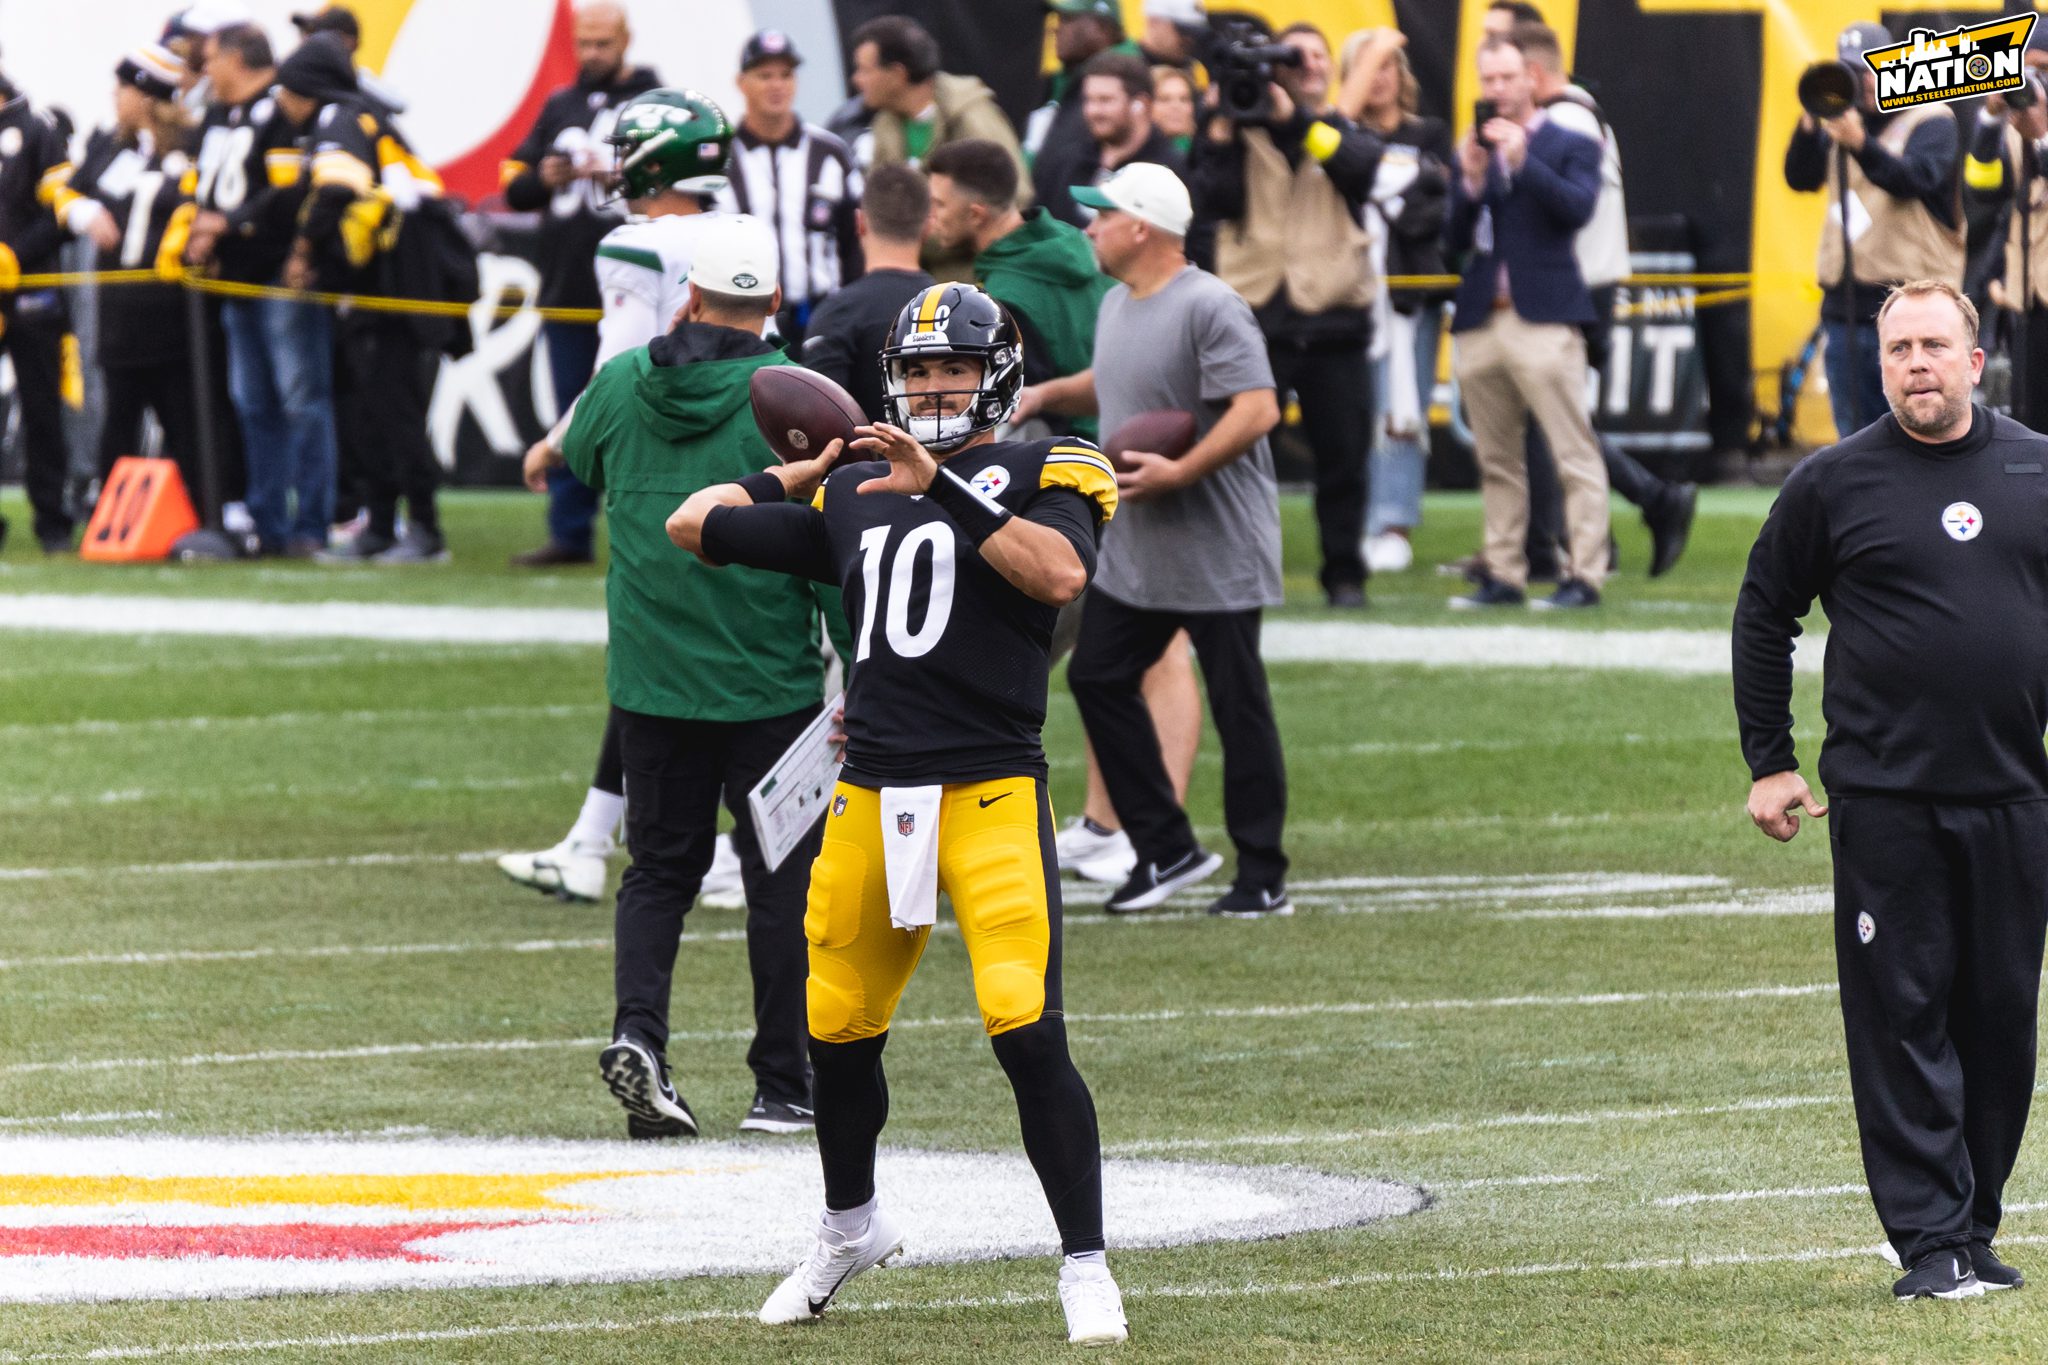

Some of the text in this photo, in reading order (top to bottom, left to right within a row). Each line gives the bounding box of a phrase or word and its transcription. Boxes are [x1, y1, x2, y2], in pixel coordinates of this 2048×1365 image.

[911, 305, 950, 334] 10
[856, 520, 956, 664] 10
[900, 822, 913, 834] NFL
